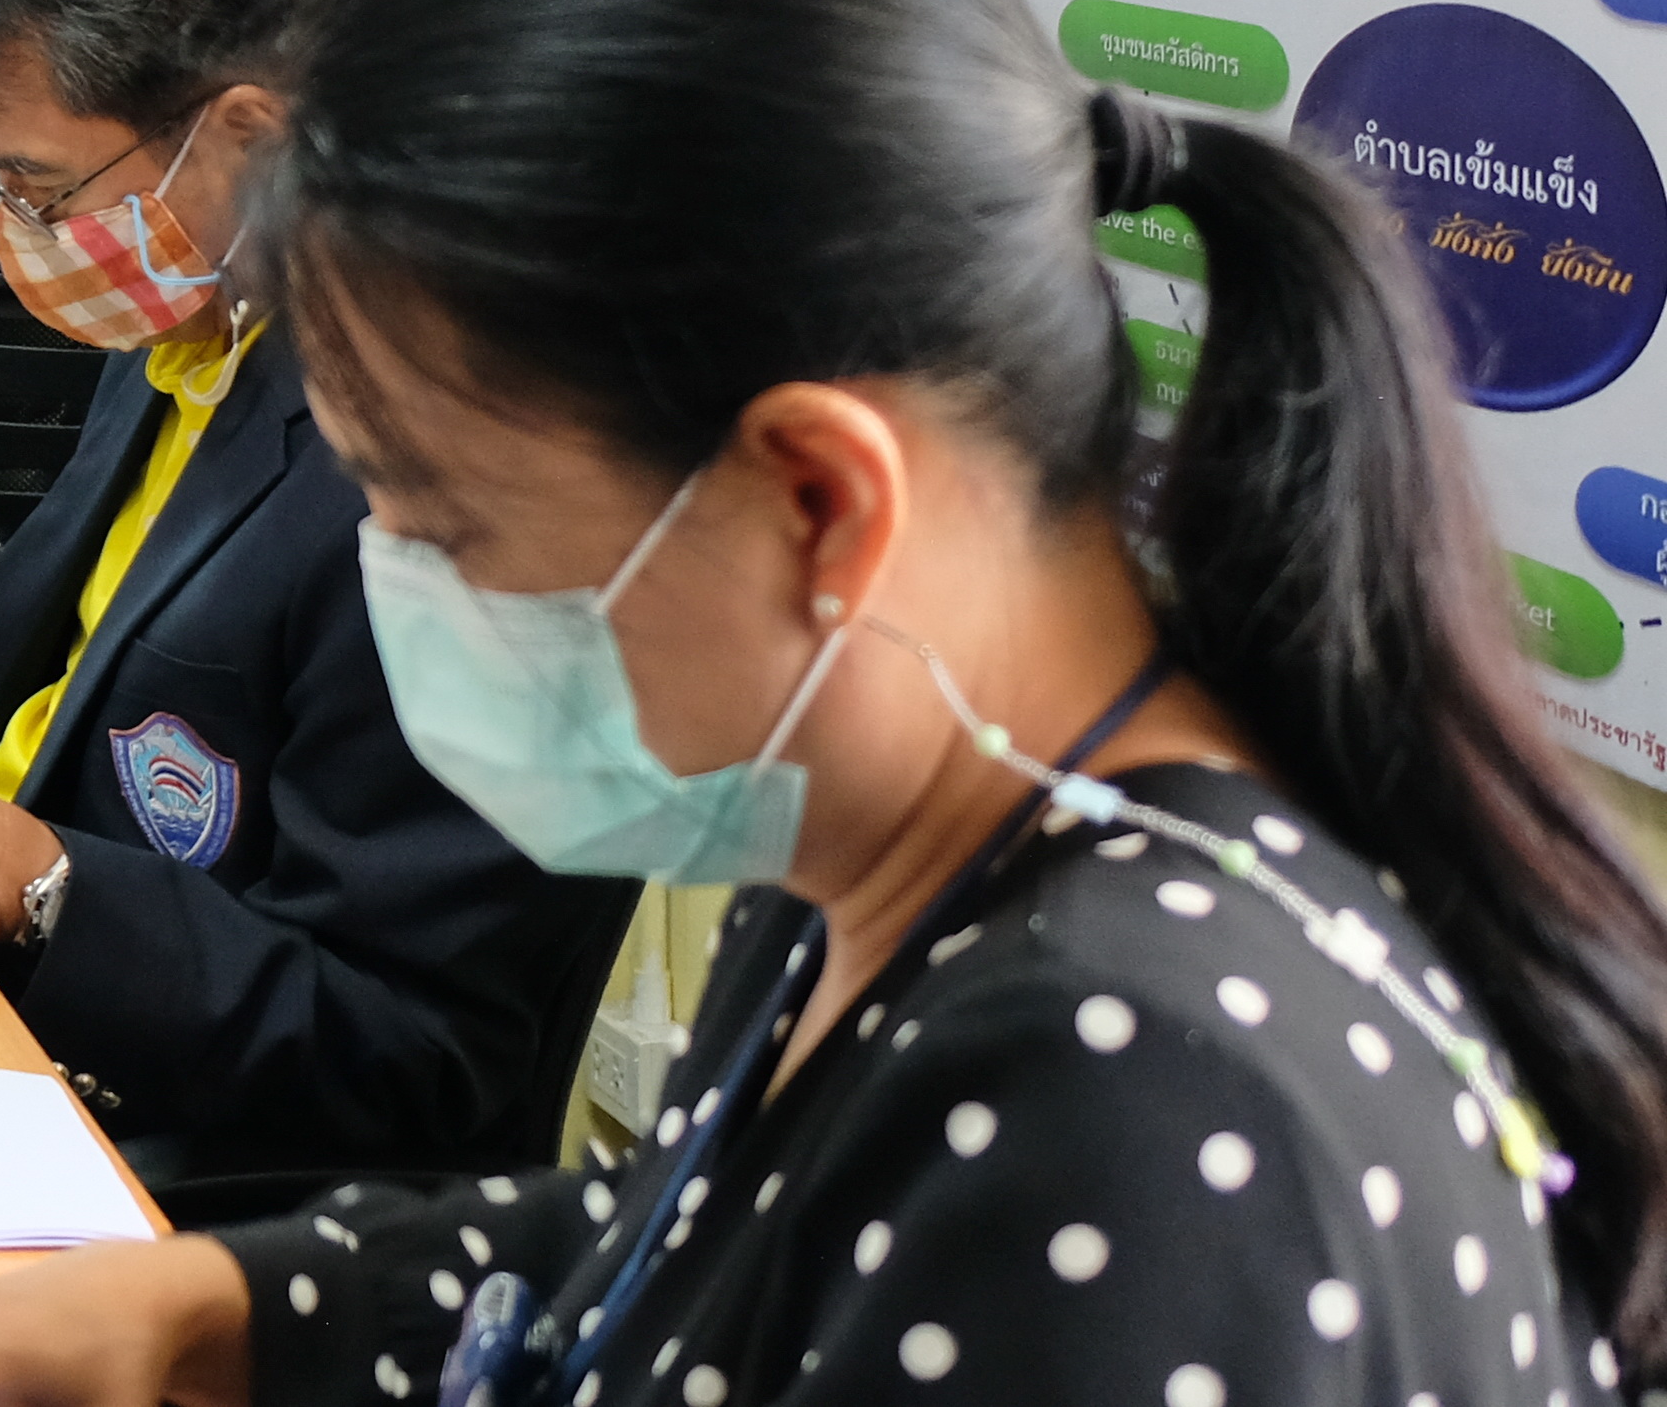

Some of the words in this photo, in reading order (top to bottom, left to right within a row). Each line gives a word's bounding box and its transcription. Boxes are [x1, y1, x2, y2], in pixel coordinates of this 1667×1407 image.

[1099, 29, 1240, 79] ชุมชนสวัสดิการ
[1353, 119, 1598, 215] ตำบลเข้มแข็ง
[1142, 217, 1177, 246] the
